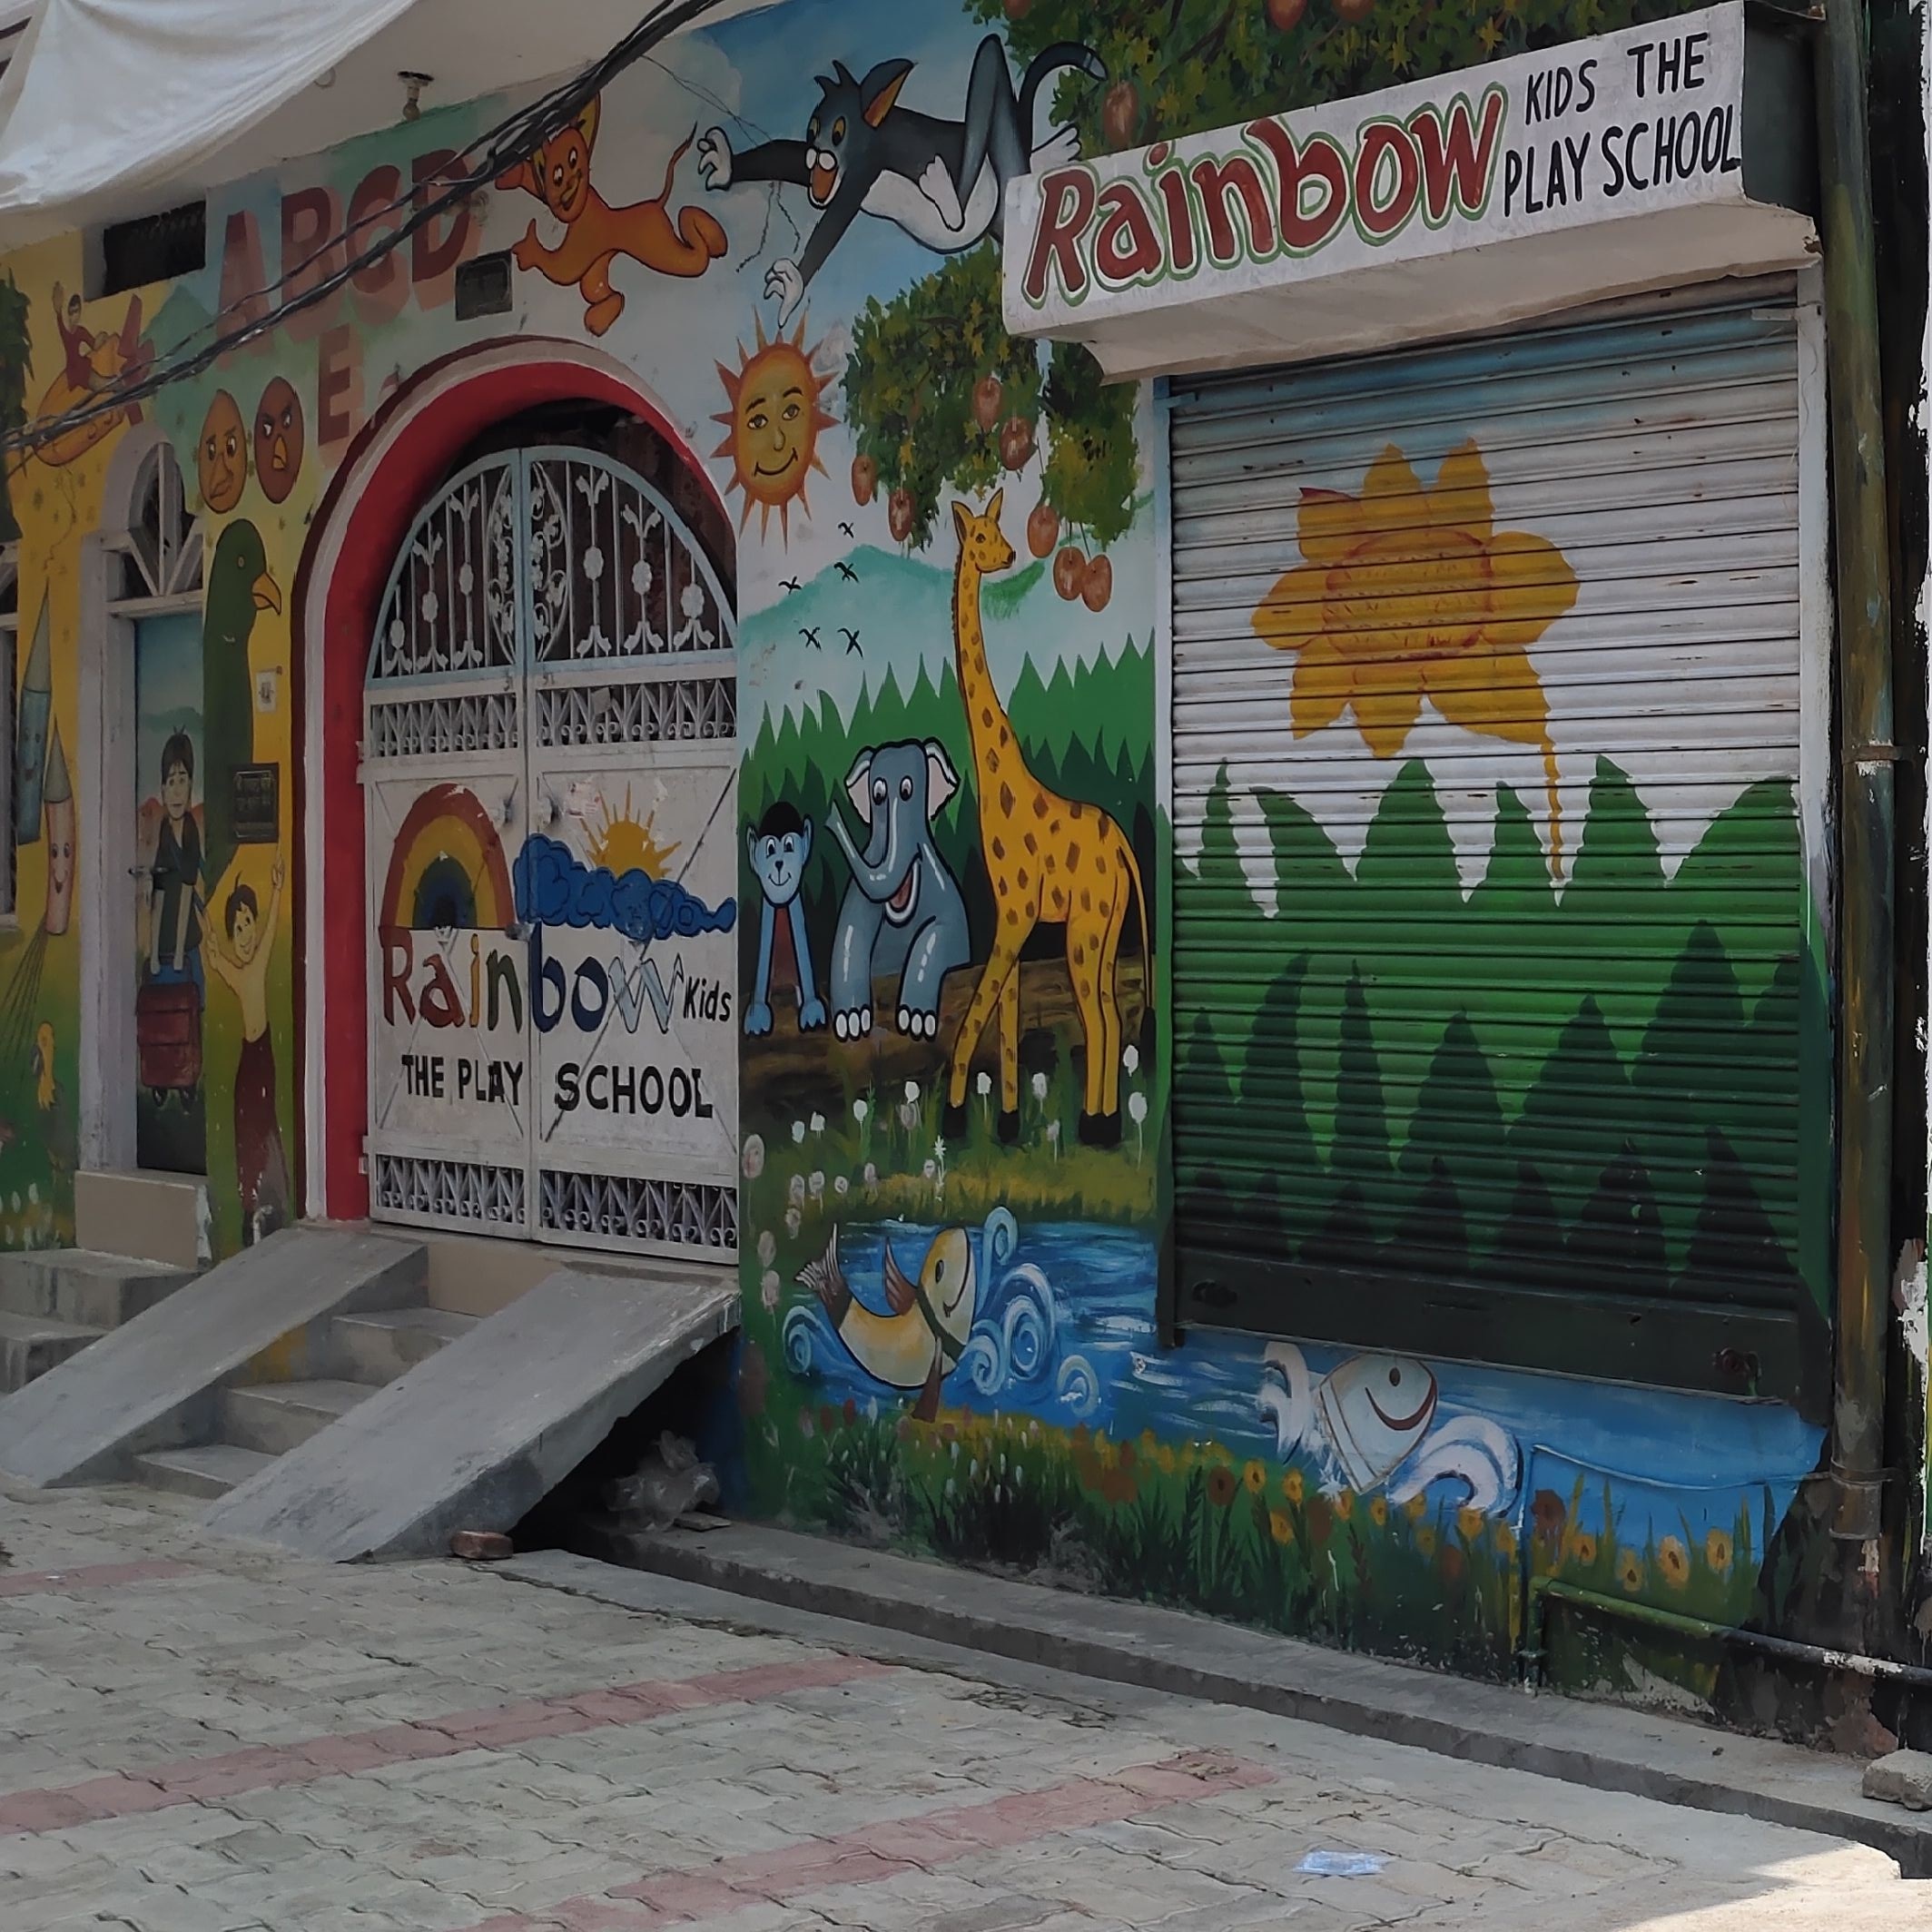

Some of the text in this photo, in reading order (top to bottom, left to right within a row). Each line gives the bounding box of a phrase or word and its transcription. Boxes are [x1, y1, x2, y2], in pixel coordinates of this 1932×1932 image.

[1524, 32, 1710, 127] KIDS THE
[1022, 82, 1509, 310] Rainbow
[1504, 104, 1741, 217] PLAY SCHOOL
[380, 921, 733, 1034] Rainbow Kids
[401, 1054, 715, 1119] THE PLAY SCHOOL
